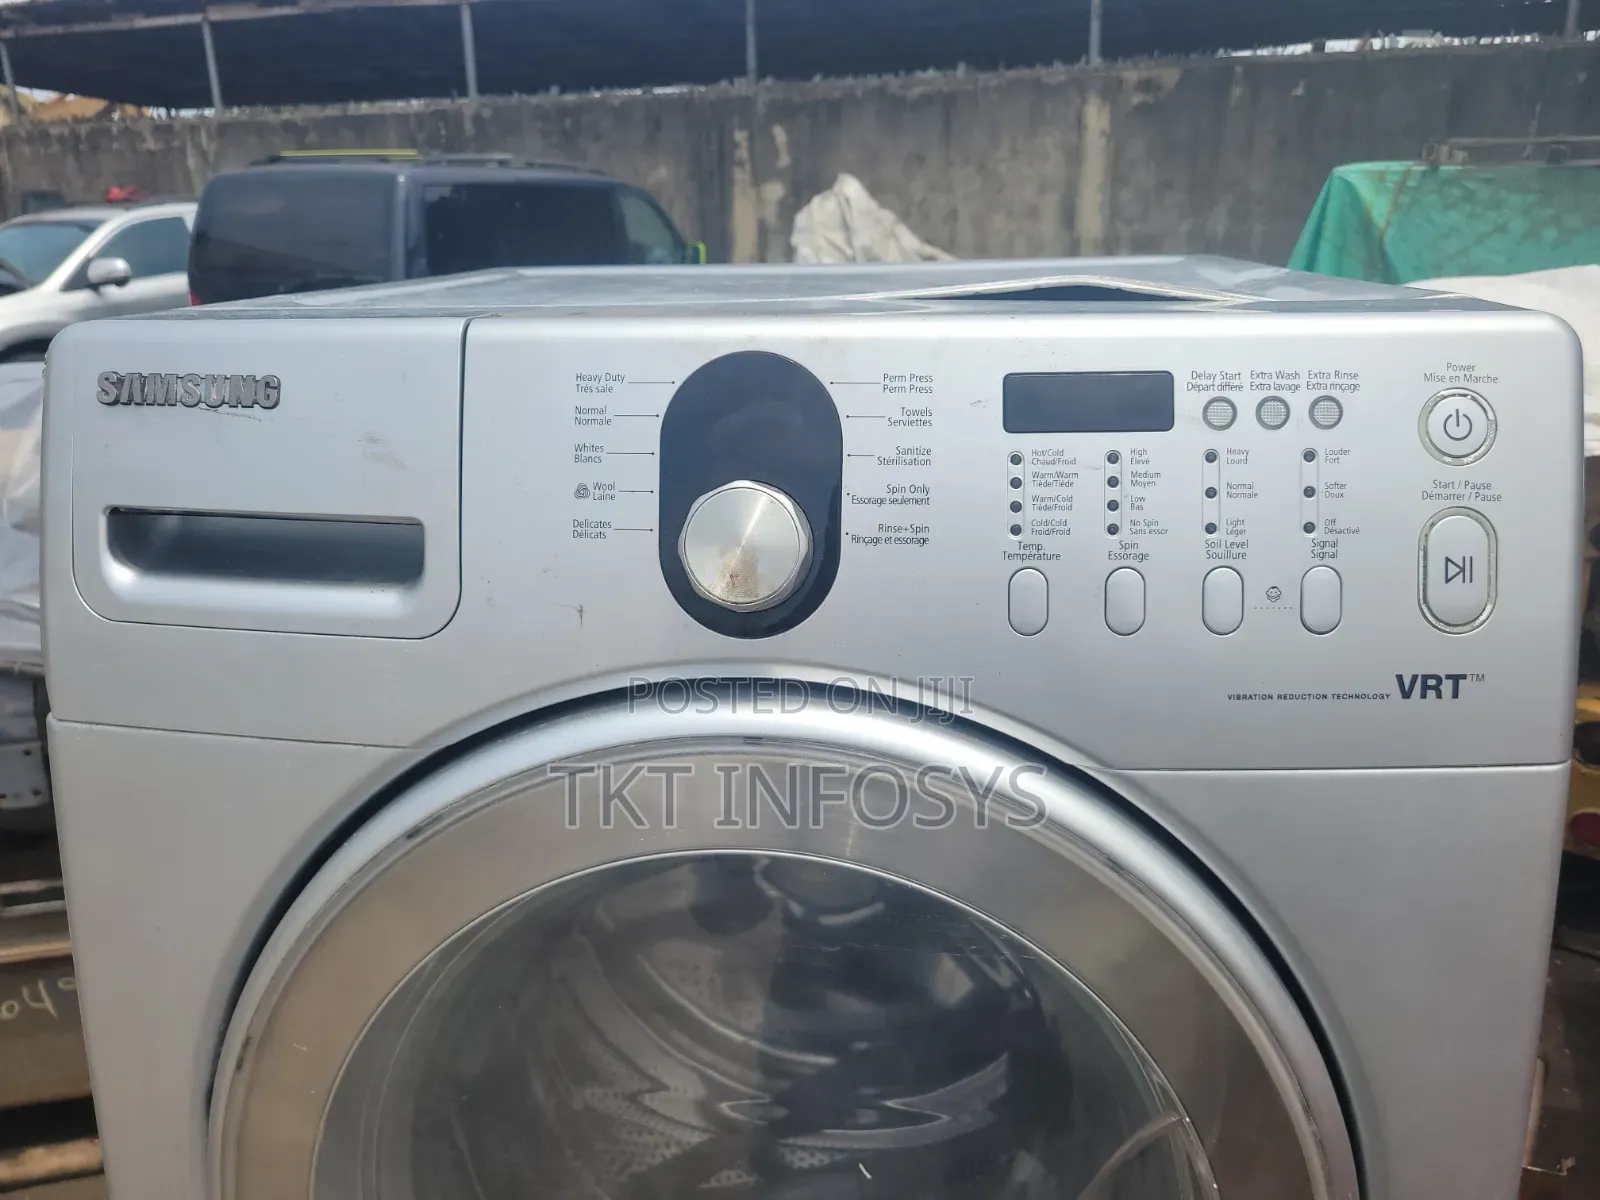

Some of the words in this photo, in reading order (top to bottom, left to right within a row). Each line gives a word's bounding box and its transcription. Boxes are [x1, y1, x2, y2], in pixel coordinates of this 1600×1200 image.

[1446, 362, 1476, 372] Power
[575, 372, 602, 384] Heavy
[605, 372, 626, 384] Duty
[883, 373, 907, 383] Perm
[909, 373, 934, 383] Press
[1191, 370, 1217, 382] Delay
[1219, 370, 1242, 381] Start
[1250, 370, 1273, 380] Extra
[1274, 370, 1301, 380] Wash
[1307, 370, 1331, 380] Extra
[1334, 370, 1359, 380] Rinse
[1423, 372, 1446, 383] Mise
[1448, 375, 1461, 383] en
[1463, 373, 1499, 384] Marche
[96, 371, 281, 409] SAMSUNG
[595, 383, 614, 393] sale
[883, 384, 907, 394] Perm
[909, 384, 933, 394] Press
[1186, 381, 1216, 392] Départ
[1216, 381, 1244, 392] différé
[1249, 381, 1272, 391] Extra
[1273, 381, 1301, 393] lavage
[1306, 381, 1329, 391] Extra
[1329, 381, 1361, 393] rinçage
[574, 405, 607, 415] Normal
[900, 406, 933, 417] Towels
[574, 417, 612, 426] Normale
[887, 416, 933, 427] Serviettes
[574, 443, 604, 453] Whites
[895, 445, 932, 456] Sanitize
[1031, 448, 1065, 457] Hot/Cold
[1130, 448, 1148, 458] High
[1226, 448, 1250, 458] Heavy
[1324, 448, 1351, 456] Louder
[574, 454, 602, 464] Blancs
[877, 455, 932, 466] Stérilisation
[1031, 457, 1077, 466] Chaud/Froid
[1226, 456, 1248, 465] Lourd
[1324, 456, 1340, 464] Fort
[1031, 471, 1079, 479] Warm/Warm
[1130, 471, 1162, 479] Medium
[592, 481, 616, 491] Wool
[886, 483, 907, 495] Spin
[909, 483, 931, 496] Only
[1130, 480, 1157, 489] Moyen
[1226, 482, 1254, 490] Normal
[1324, 482, 1347, 490] Softer
[1432, 480, 1455, 490] Start
[1464, 480, 1492, 491] Pause
[592, 492, 616, 501] Laine
[1031, 494, 1073, 503] Warm/Cold
[1130, 495, 1146, 503] Low
[1226, 490, 1259, 499] Normale
[1324, 490, 1345, 499] Doux
[1421, 490, 1466, 501] Démarrer
[1474, 491, 1503, 502] Pause
[851, 494, 887, 507] Essorage
[888, 494, 931, 506] seulement
[1130, 503, 1144, 511] Bas
[572, 519, 612, 529] Delicates
[1031, 519, 1067, 527] Cold/Cold
[1130, 519, 1141, 527] No
[1143, 519, 1159, 529] Spin
[1226, 518, 1245, 528] Light
[1324, 518, 1336, 527] Off
[572, 529, 607, 539] Délicats
[878, 523, 930, 535] Rinse+Spin
[1031, 527, 1071, 536] Froid/Froid
[1129, 528, 1147, 536] Sans
[1226, 527, 1247, 537] Léger
[1324, 526, 1361, 535] Désactivé
[851, 534, 883, 547] Rinçage
[884, 535, 893, 545] et
[893, 535, 930, 547] essorage
[1204, 539, 1222, 549] Soil
[1224, 539, 1249, 549] Level
[1311, 538, 1339, 550] Signal
[1017, 541, 1046, 553] Temp.
[1119, 540, 1139, 552] Spin
[1003, 551, 1061, 563] Température
[1108, 551, 1150, 563] Essorage
[1205, 549, 1247, 560] Souillure
[1311, 549, 1339, 561] Signal
[1395, 673, 1467, 700] VRT
[1276, 693, 1328, 701] REDUCTION
[1331, 693, 1391, 701] TECHNOLOGY
